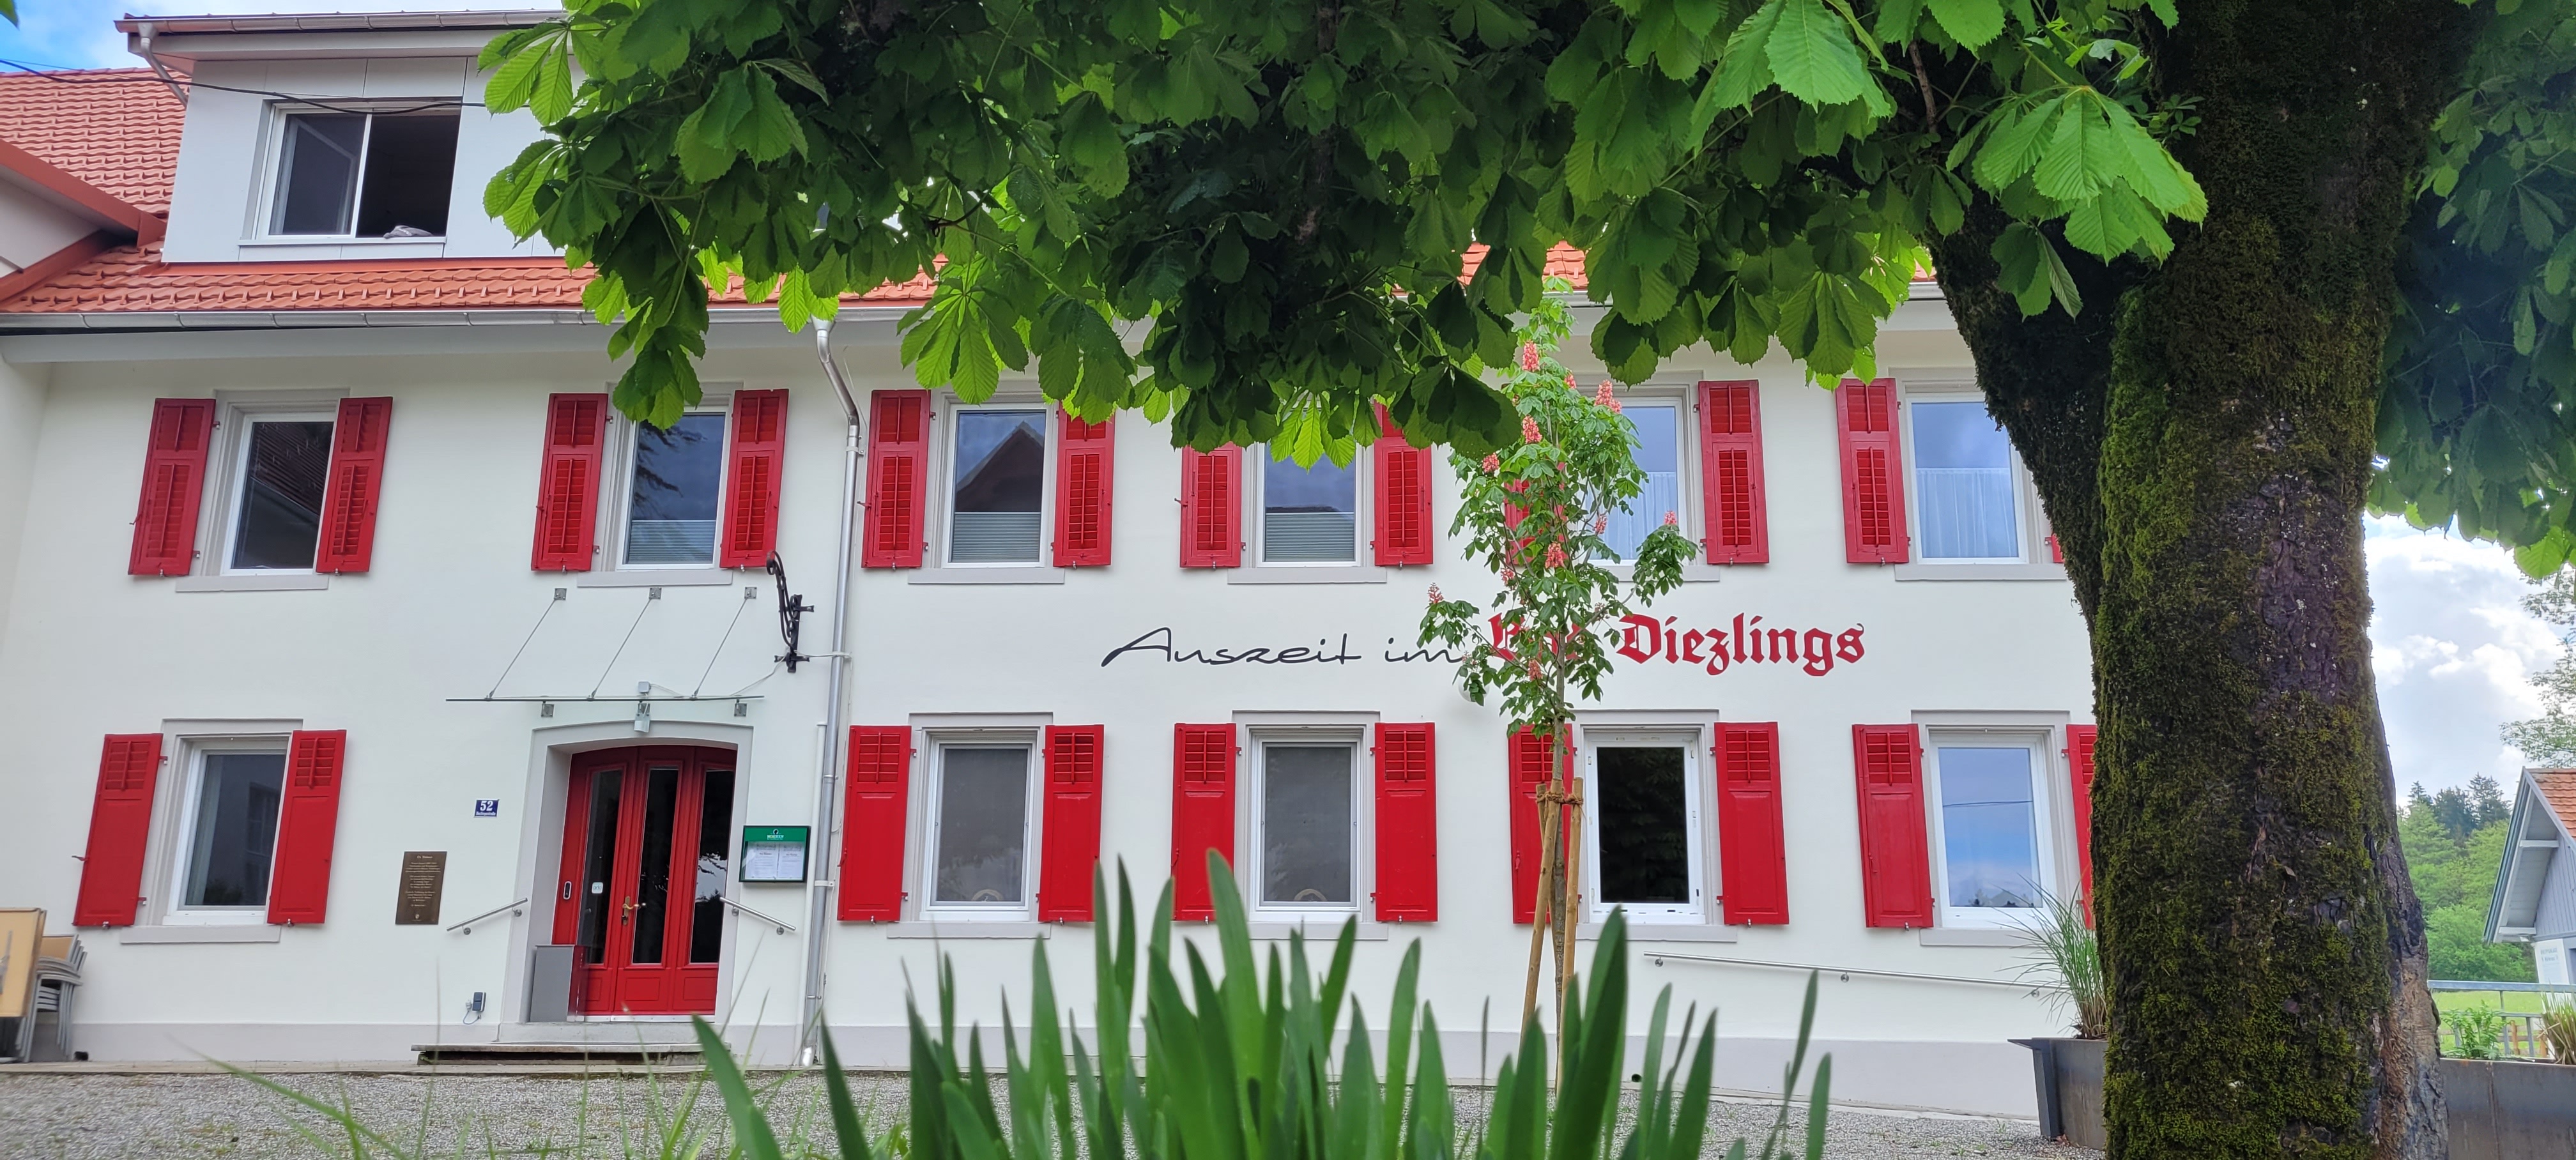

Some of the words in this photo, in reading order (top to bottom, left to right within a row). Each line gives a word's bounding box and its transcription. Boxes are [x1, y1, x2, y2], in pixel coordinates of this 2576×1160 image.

[1100, 627, 1361, 666] Auszeit
[1384, 637, 1464, 664] im
[1616, 612, 1865, 676] Diezlings
[480, 800, 494, 811] 52
